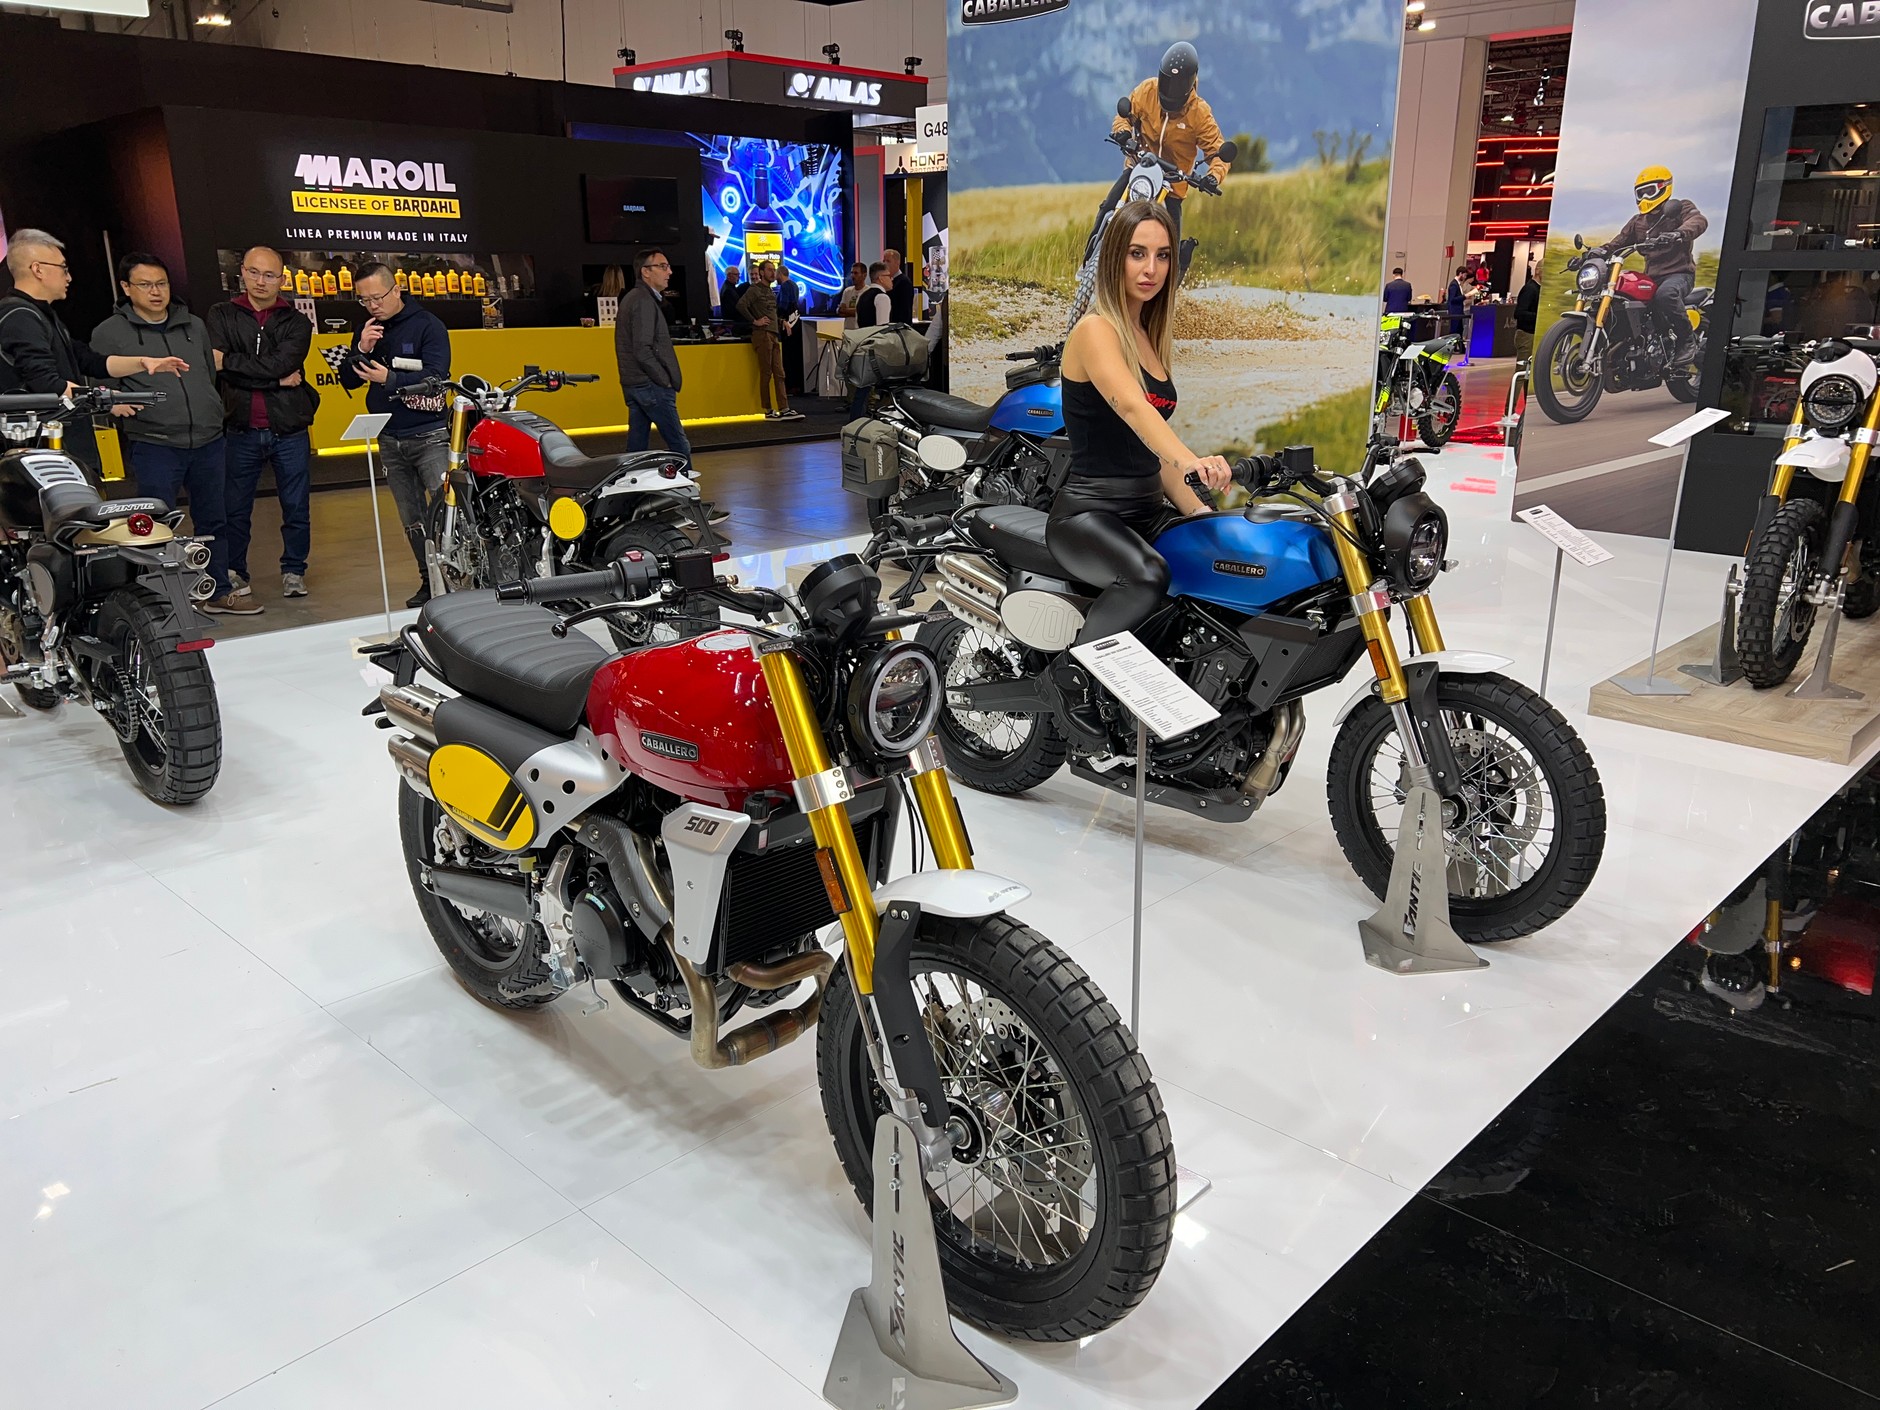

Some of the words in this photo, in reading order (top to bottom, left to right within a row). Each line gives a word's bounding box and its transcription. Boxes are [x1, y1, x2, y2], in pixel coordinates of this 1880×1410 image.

[651, 68, 710, 95] ANLAS
[814, 76, 883, 106] ANLAS
[910, 153, 948, 167] HONP
[294, 154, 457, 193] MAROIL
[296, 196, 367, 210] LICENSEE
[371, 200, 389, 211] OF
[393, 198, 457, 218] BARDAHL
[286, 228, 323, 239] LINEA
[328, 229, 383, 241] PREMIUM
[387, 231, 418, 242] MADE
[423, 233, 435, 242] IN
[439, 233, 468, 243] ITALY
[97, 502, 155, 516] FANTIC
[1214, 562, 1264, 576] CABALLERO
[641, 736, 697, 758] CABALLERO
[683, 815, 720, 836] 500
